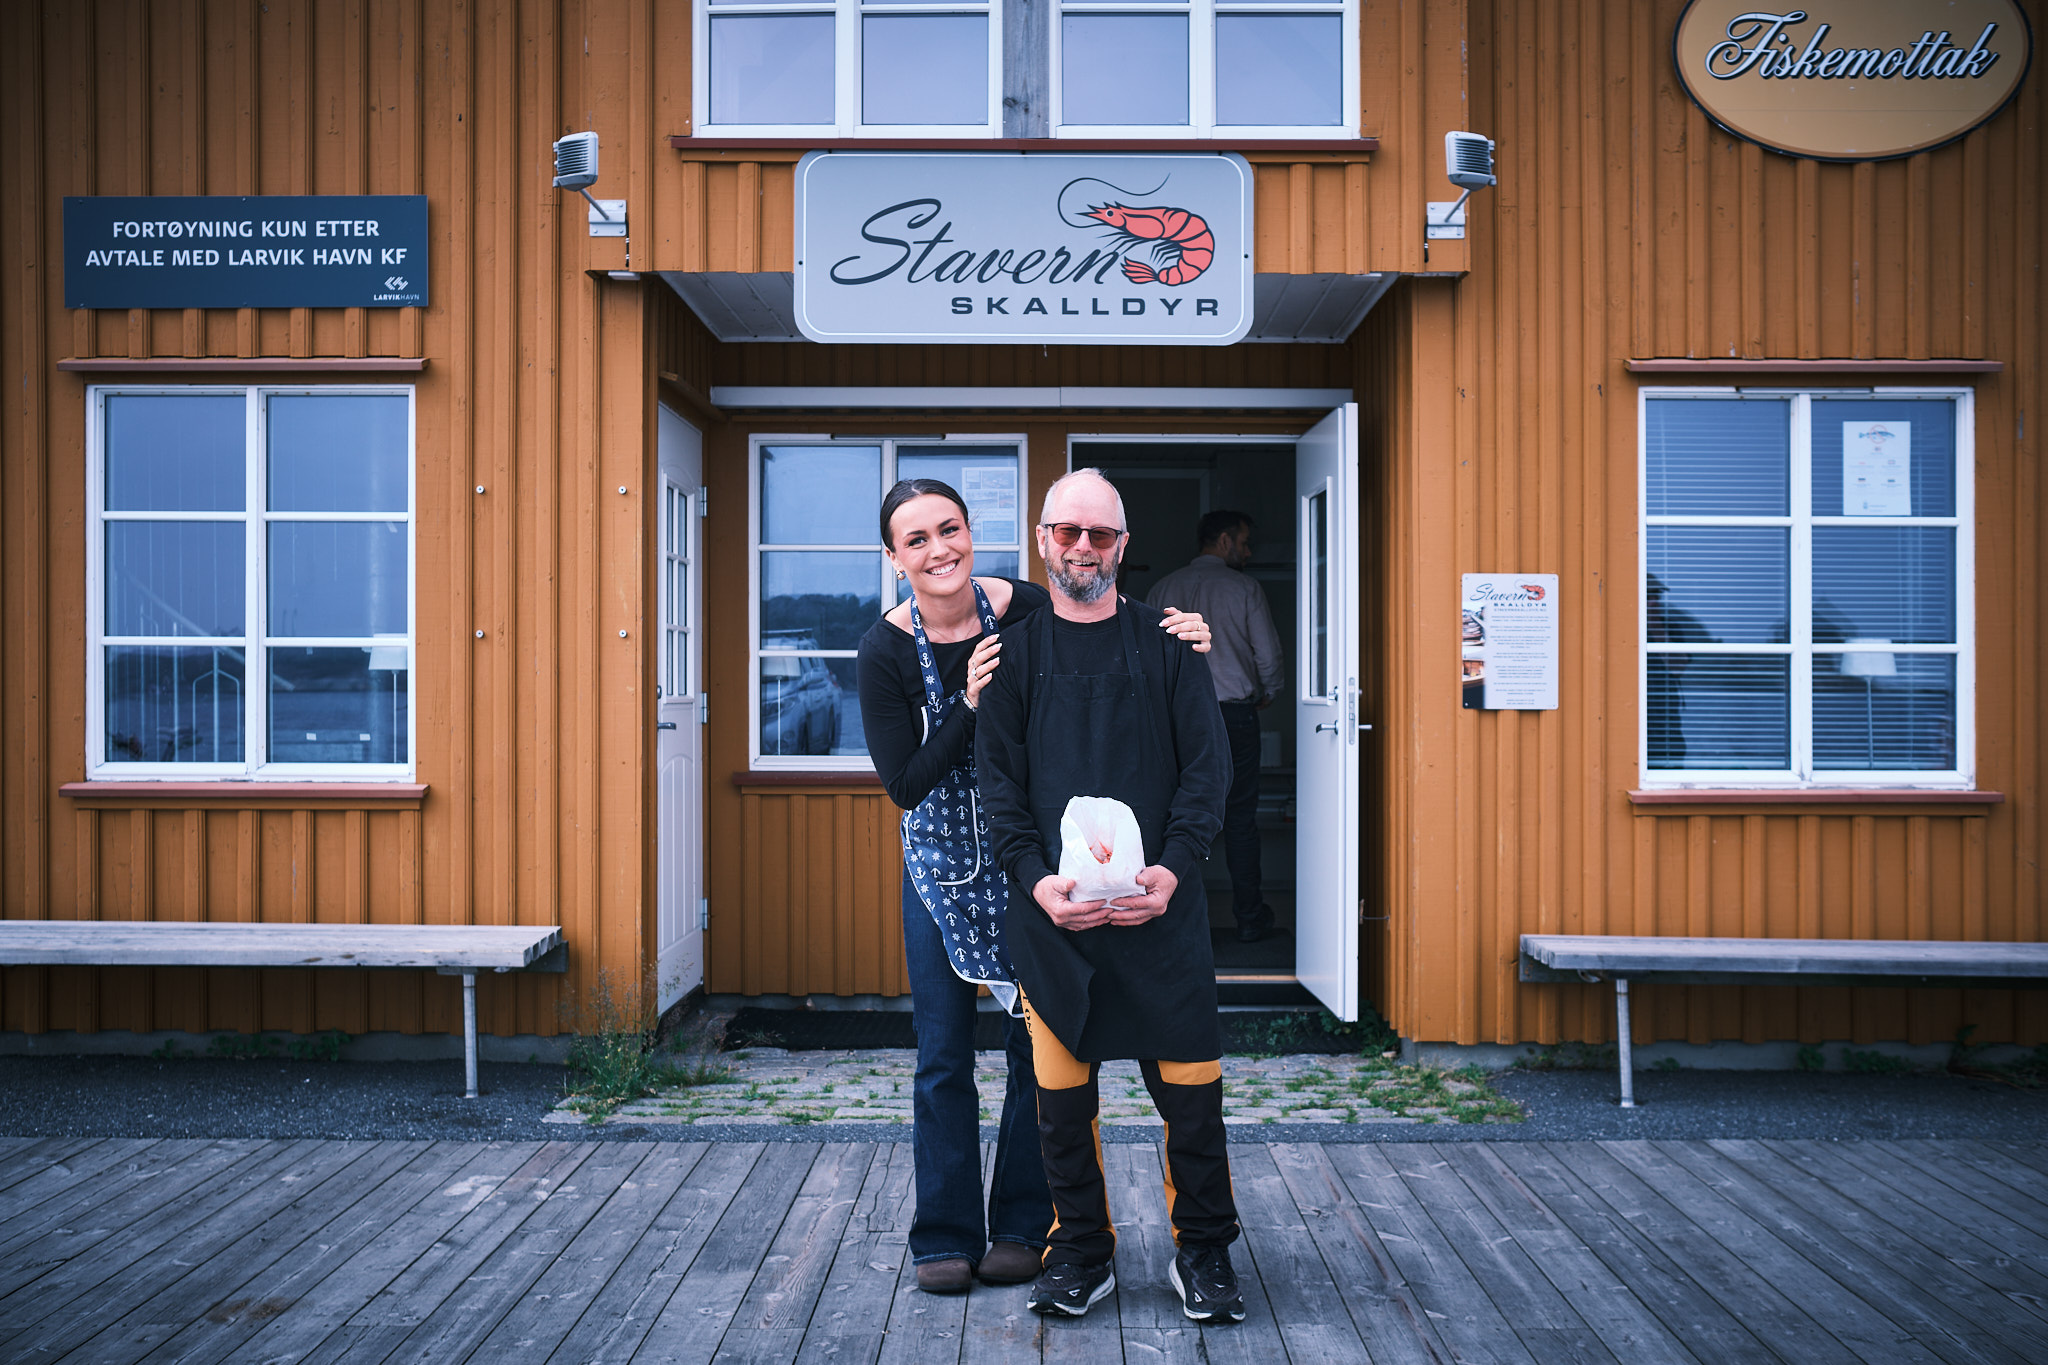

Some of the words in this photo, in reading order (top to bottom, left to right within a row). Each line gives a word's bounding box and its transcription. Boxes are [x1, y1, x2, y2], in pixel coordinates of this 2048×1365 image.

[1704, 10, 1999, 79] Fiskemottak
[113, 220, 253, 238] FORTØYNING
[261, 220, 307, 238] KUN
[315, 219, 380, 237] ETTER
[830, 198, 1120, 286] Stavern
[85, 249, 165, 267] AVTALE
[172, 249, 220, 266] MED
[228, 248, 305, 266] LARVIK
[312, 248, 372, 266] HAVN
[381, 247, 408, 265] KF
[951, 296, 1218, 316] SKALLDYR
[1470, 583, 1528, 601] Stavern
